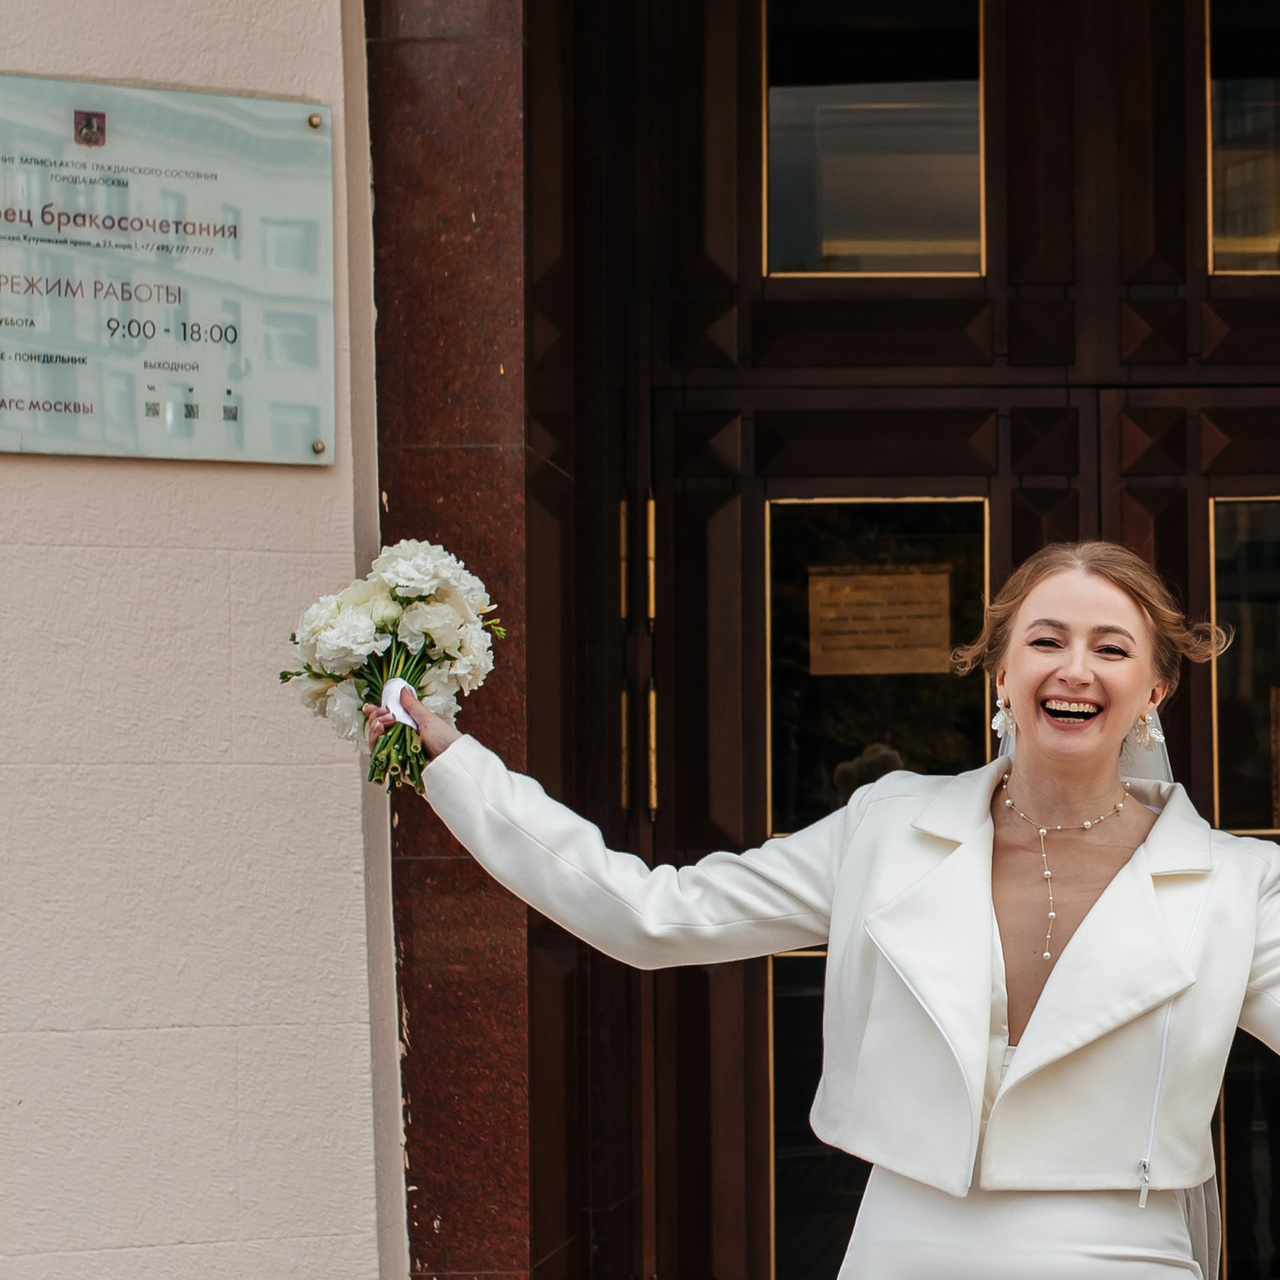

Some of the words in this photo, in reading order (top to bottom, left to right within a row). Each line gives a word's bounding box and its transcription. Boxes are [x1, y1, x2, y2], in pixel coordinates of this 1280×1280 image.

[91, 163, 163, 177] ГРАЖДАНСКОГО
[50, 173, 87, 185] ГОРОДА
[89, 176, 129, 188] МОСКВЫ
[0, 207, 33, 228] ец
[41, 202, 238, 239] бракосочетания
[0, 274, 84, 298] РЕЖИМ
[93, 280, 181, 305] РАБОТЫ
[107, 318, 156, 339] 9:00
[181, 322, 238, 344] 18:00
[15, 352, 87, 365] ПОНЕДЕЛЬНИК
[143, 361, 200, 372] ВЫХОДНОЙ
[28, 400, 93, 415] МОСКВЫ
